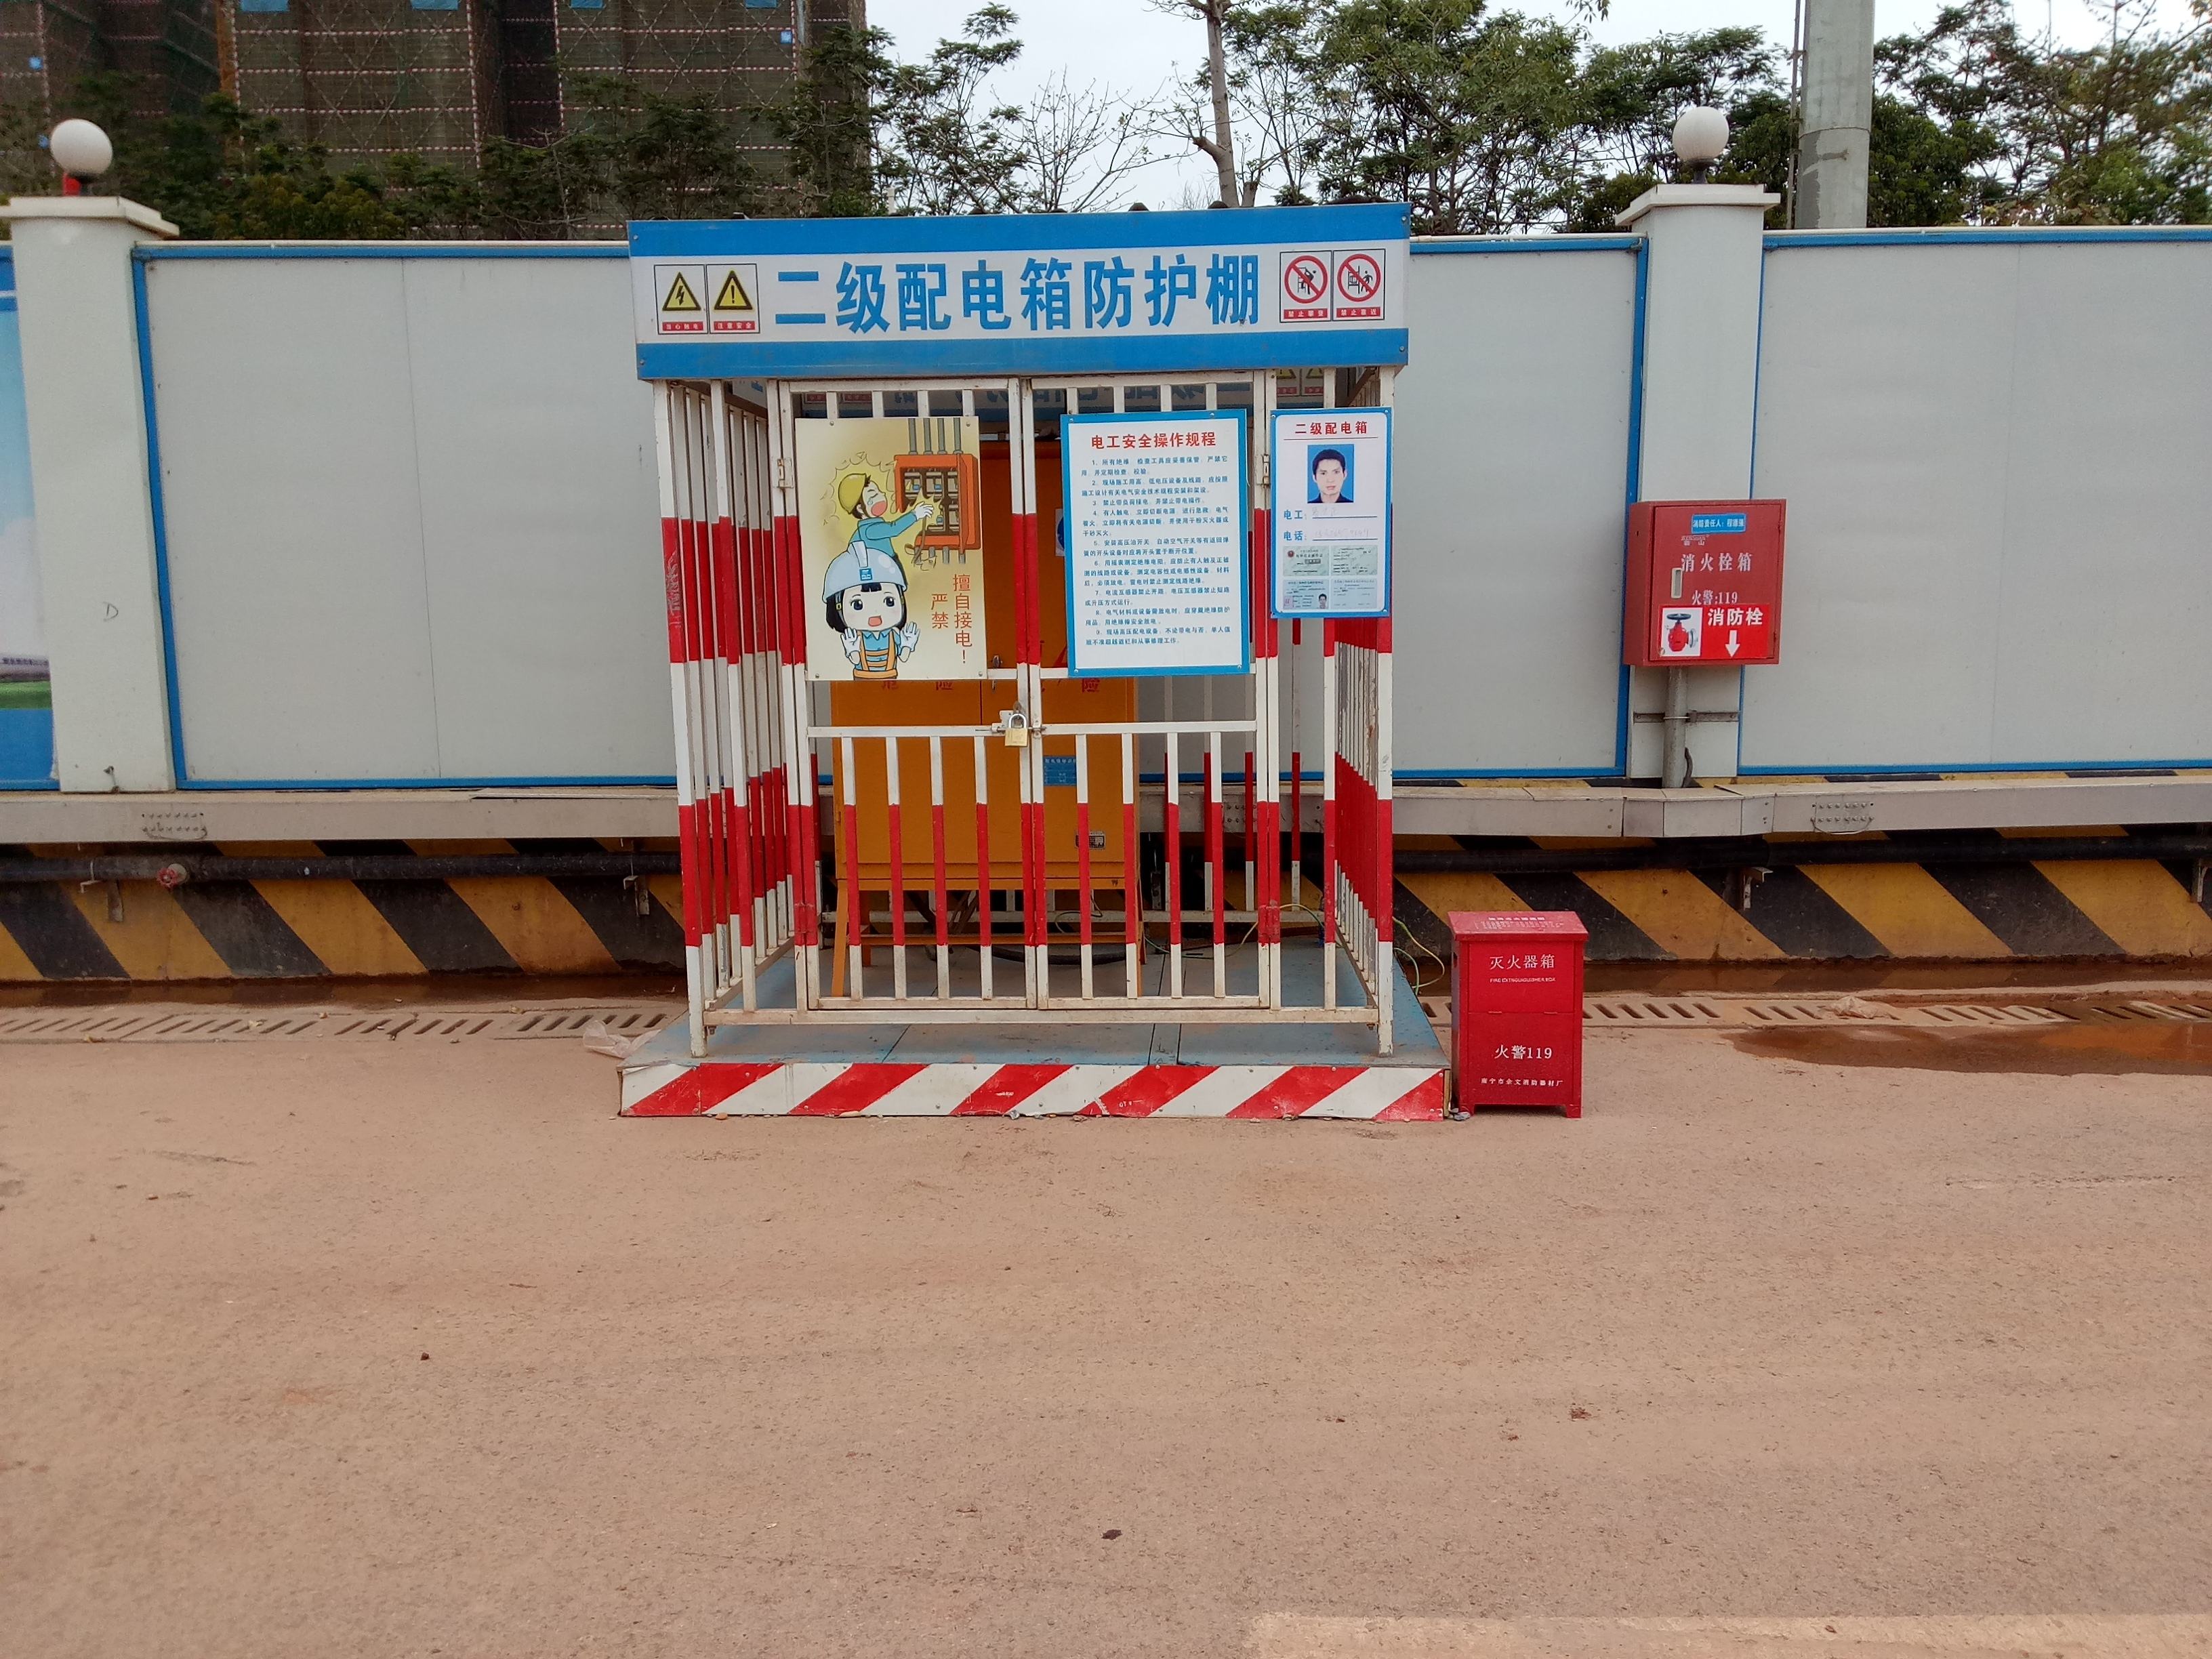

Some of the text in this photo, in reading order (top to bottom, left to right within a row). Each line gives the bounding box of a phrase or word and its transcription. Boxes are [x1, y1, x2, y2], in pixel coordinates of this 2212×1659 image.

[775, 253, 1258, 334] 二级配电箱防护棚
[1294, 420, 1368, 435] 二级配电箱
[1090, 431, 1216, 450] 电工安全操作规程
[1680, 552, 1753, 573] 消火栓箱
[930, 593, 949, 630] 严禁
[1707, 607, 1764, 626] 消防栓
[1489, 954, 1555, 970] 灭火器箱
[1494, 1044, 1553, 1061] 火警119
